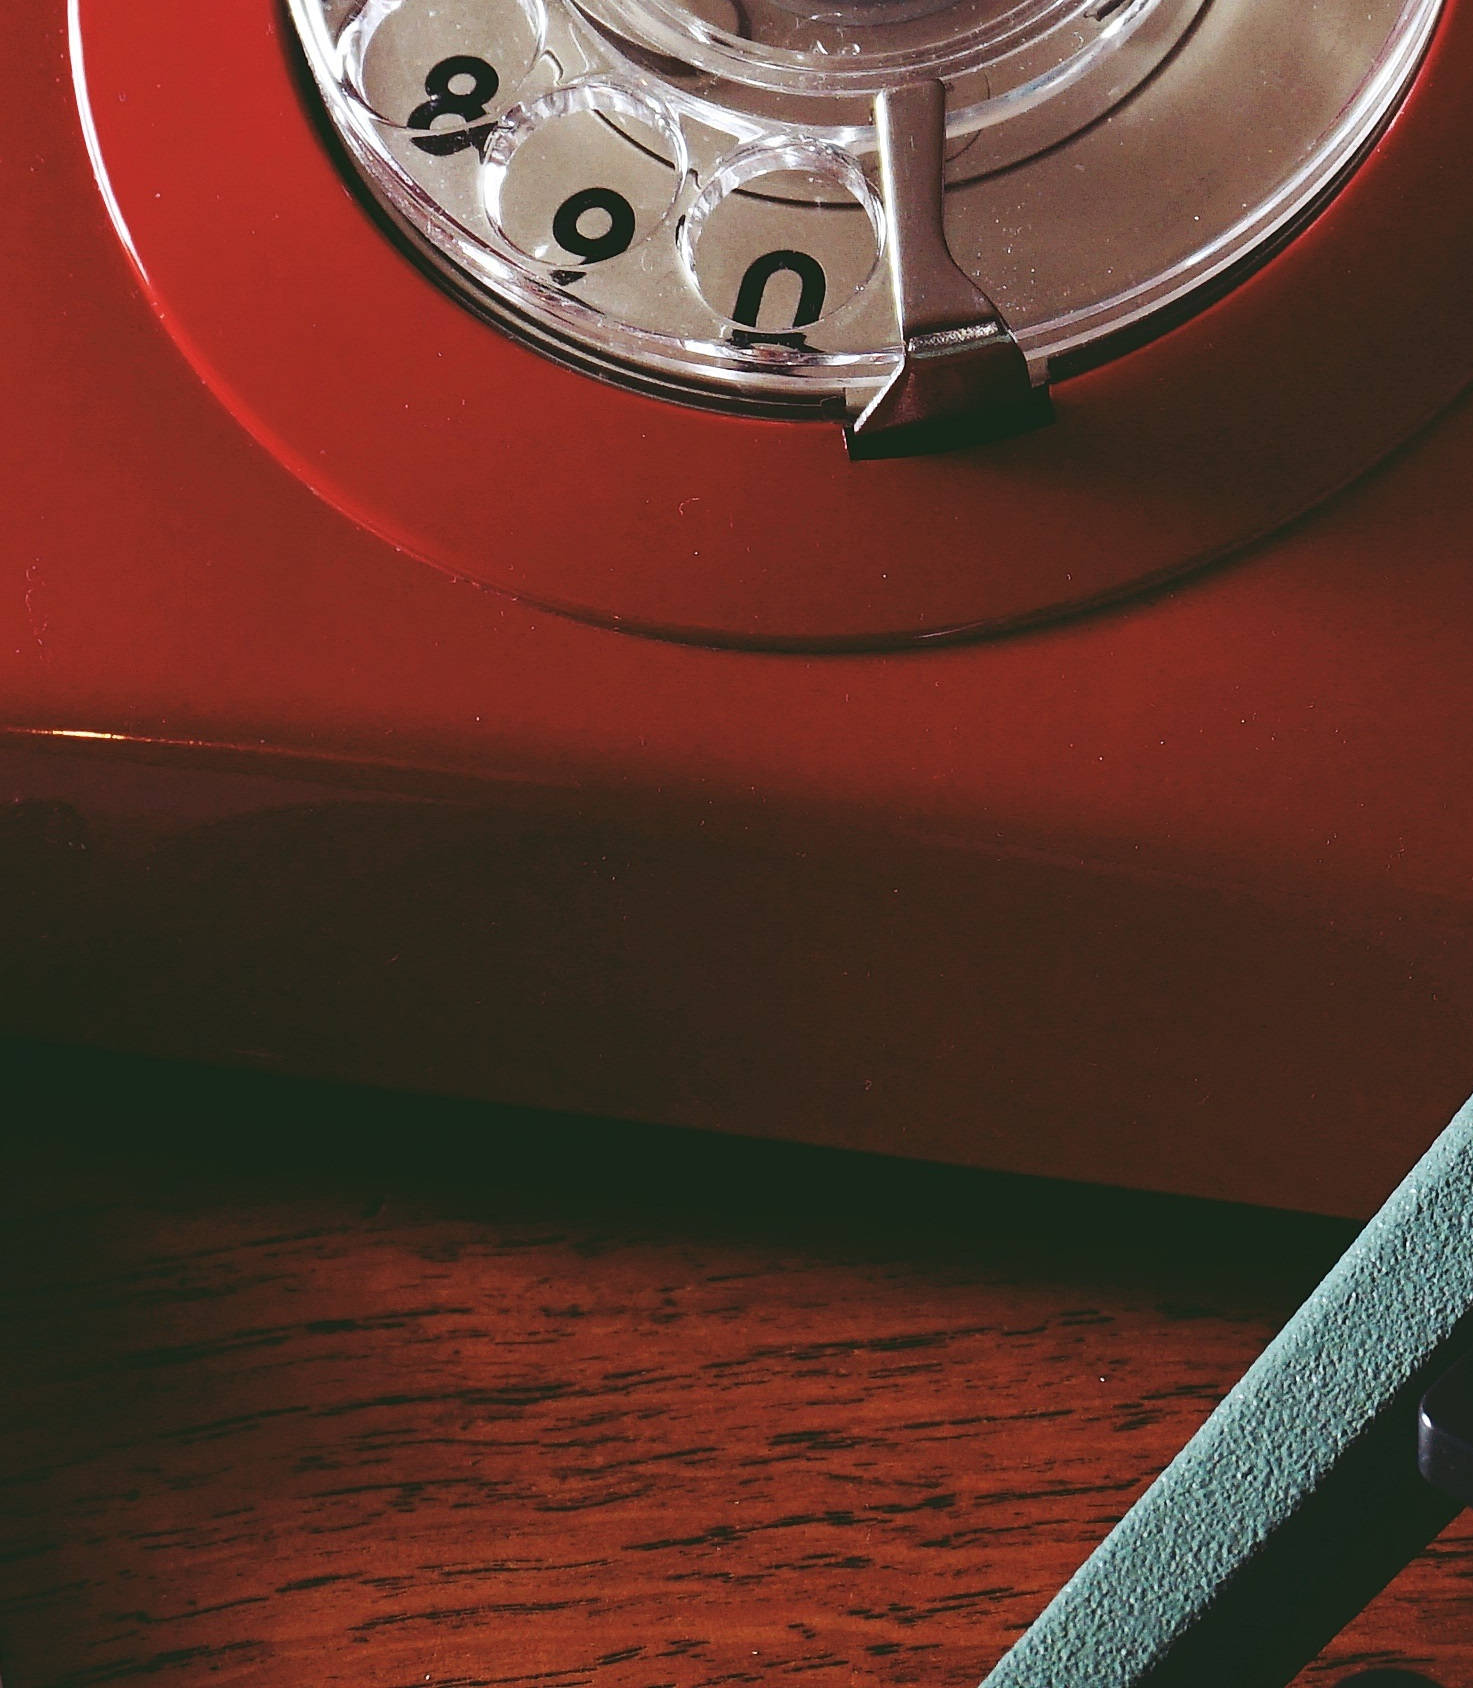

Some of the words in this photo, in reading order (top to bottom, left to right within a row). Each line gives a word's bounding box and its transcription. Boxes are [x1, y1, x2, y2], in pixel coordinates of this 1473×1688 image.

[406, 54, 501, 158] 8
[548, 186, 636, 287] 9
[727, 249, 827, 355] 0
